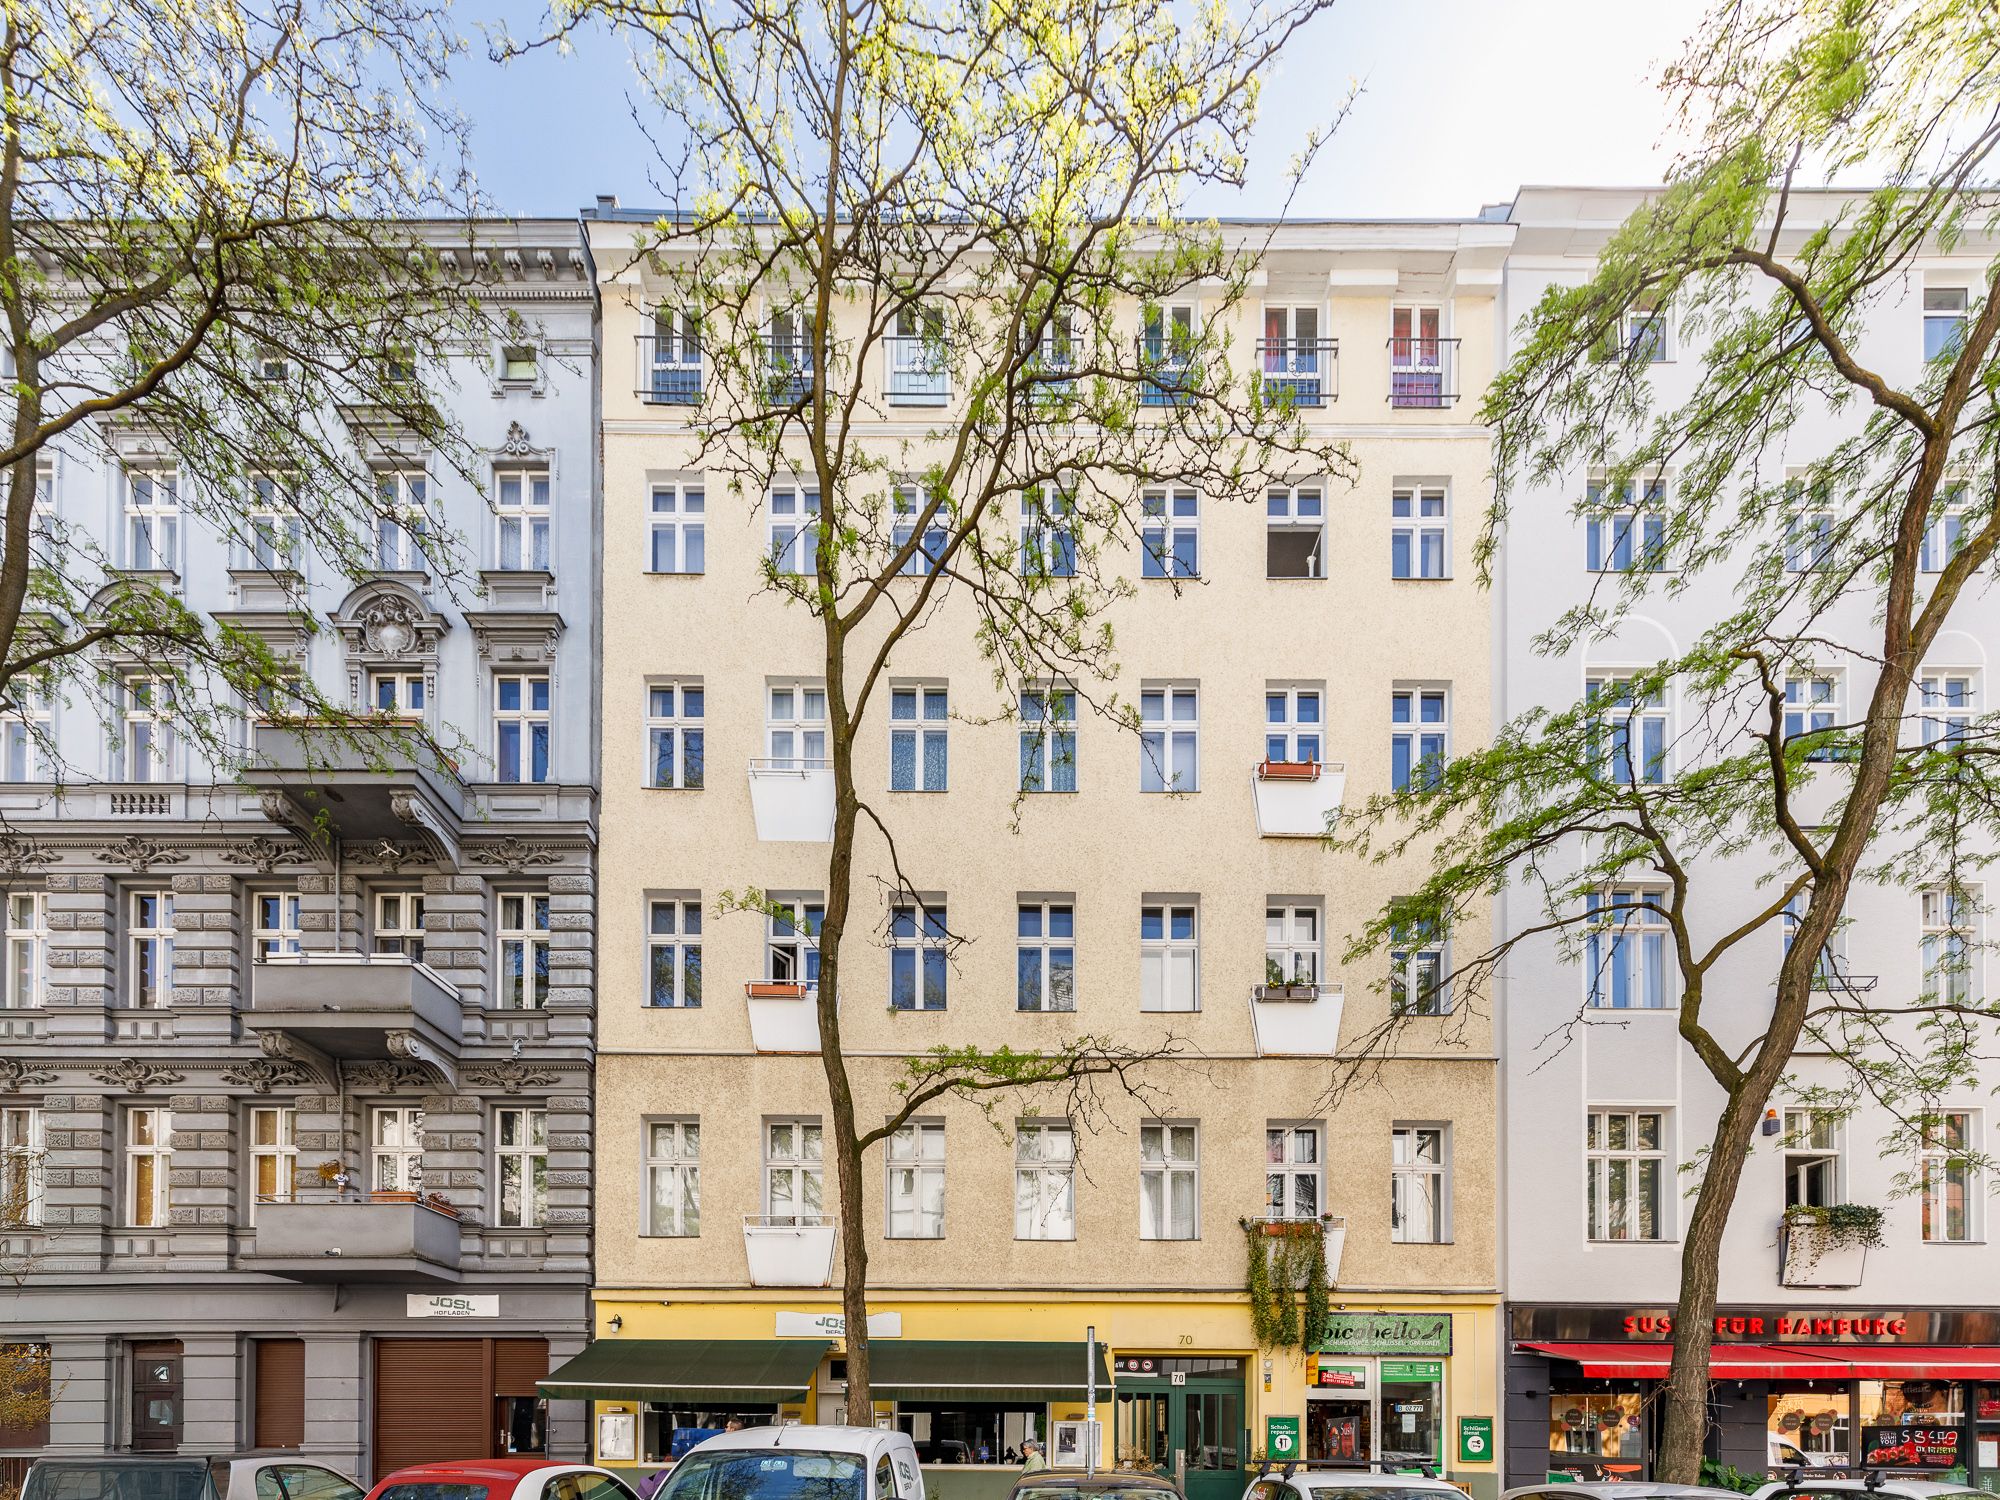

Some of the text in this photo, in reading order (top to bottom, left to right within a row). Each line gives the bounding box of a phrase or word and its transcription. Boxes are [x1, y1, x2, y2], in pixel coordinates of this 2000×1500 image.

[429, 1297, 476, 1311] JOSL
[815, 1317, 846, 1330] JOS
[1623, 1316, 1671, 1333] SUS
[1777, 1318, 1907, 1335] HAMBURG
[1178, 1334, 1193, 1345] 70
[1173, 1374, 1184, 1383] 70
